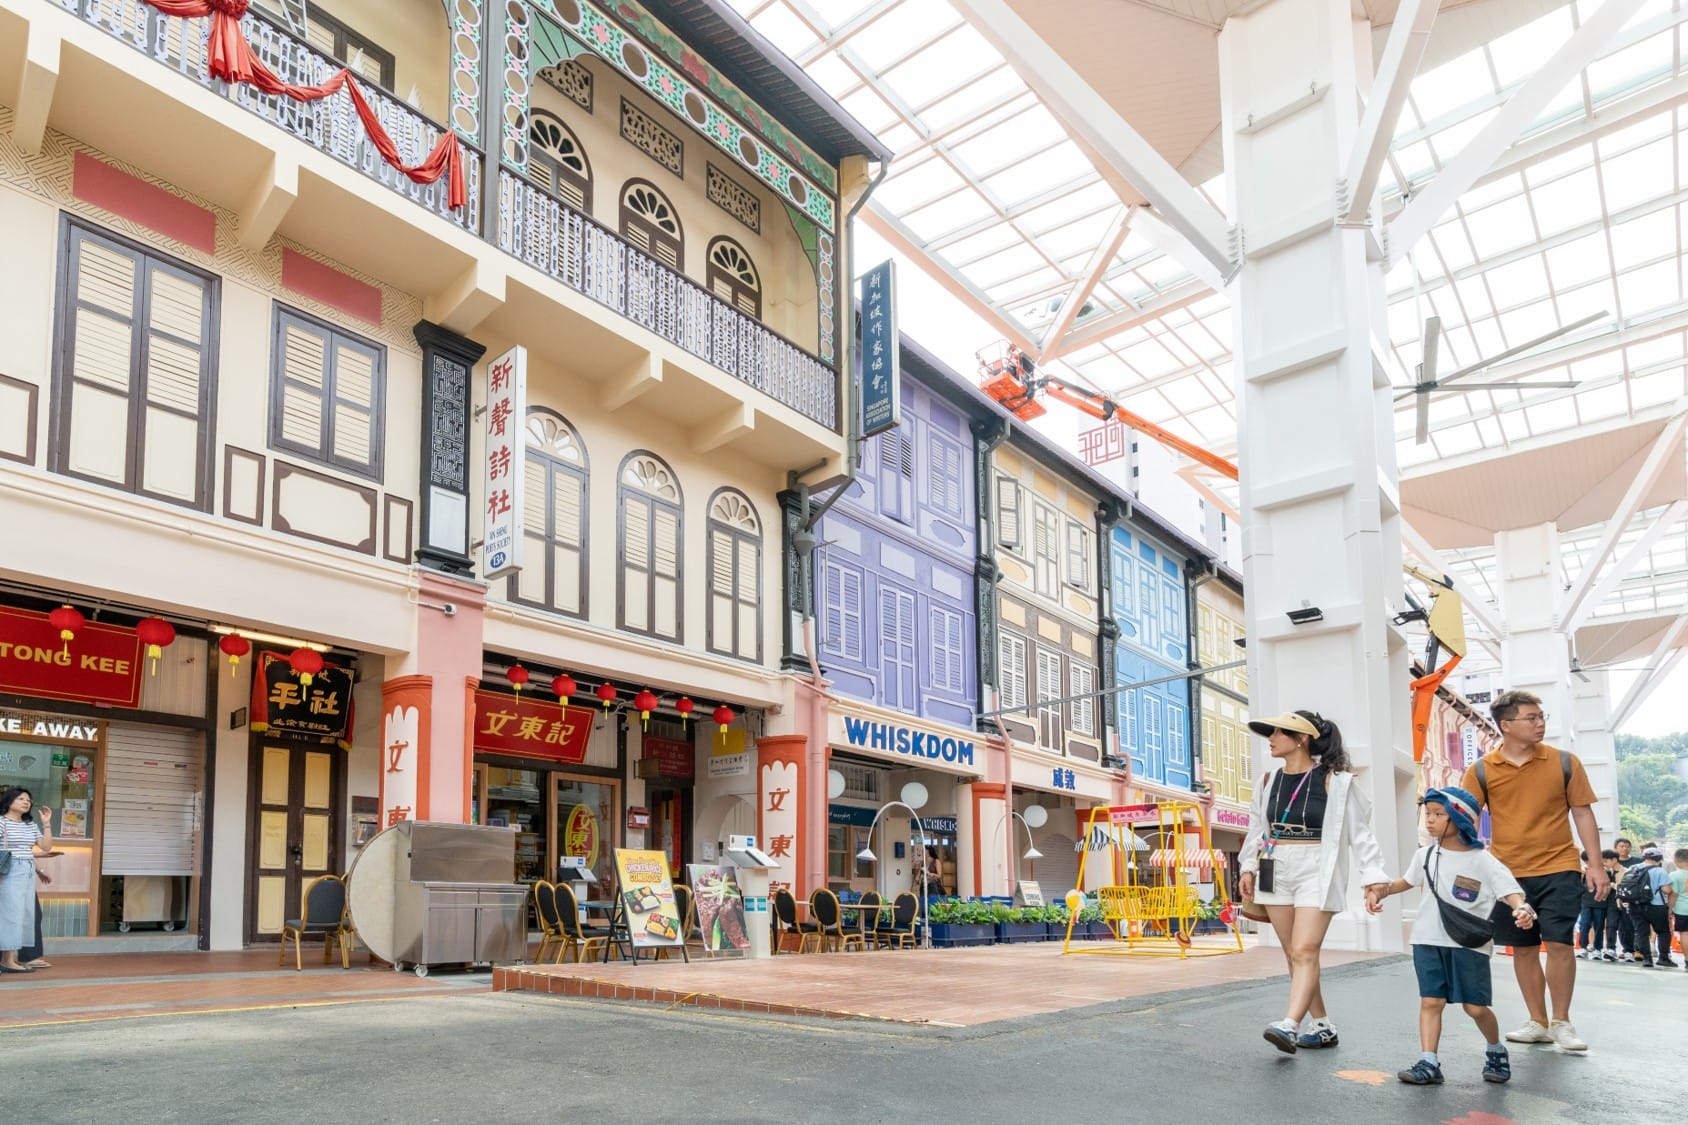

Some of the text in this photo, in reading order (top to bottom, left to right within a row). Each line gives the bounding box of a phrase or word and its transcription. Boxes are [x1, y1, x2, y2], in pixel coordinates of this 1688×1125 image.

[488, 357, 513, 525] 新聲詩社
[0, 642, 130, 675] TONG KEE
[268, 682, 340, 715] 平社
[33, 722, 98, 741] AWAY
[480, 709, 575, 746] 文東記
[844, 716, 974, 766] WHISKDOM
